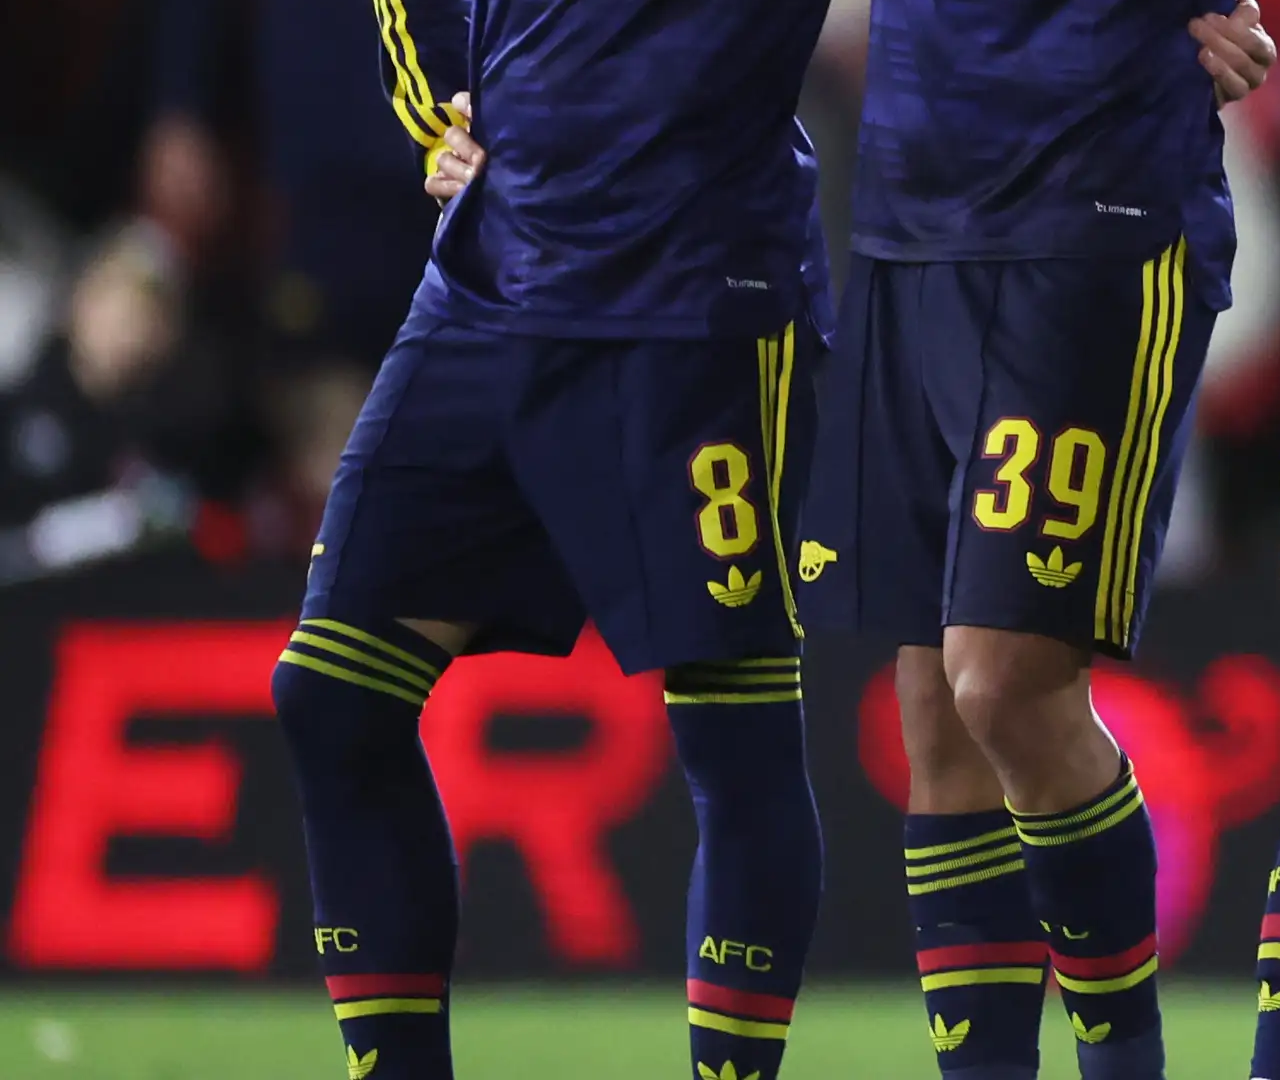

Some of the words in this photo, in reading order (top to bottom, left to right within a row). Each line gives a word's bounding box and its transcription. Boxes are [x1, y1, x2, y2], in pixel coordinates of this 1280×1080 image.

[687, 440, 760, 558] 8
[973, 417, 1107, 540] 39
[314, 926, 358, 955] FC
[699, 935, 774, 972] AFC
